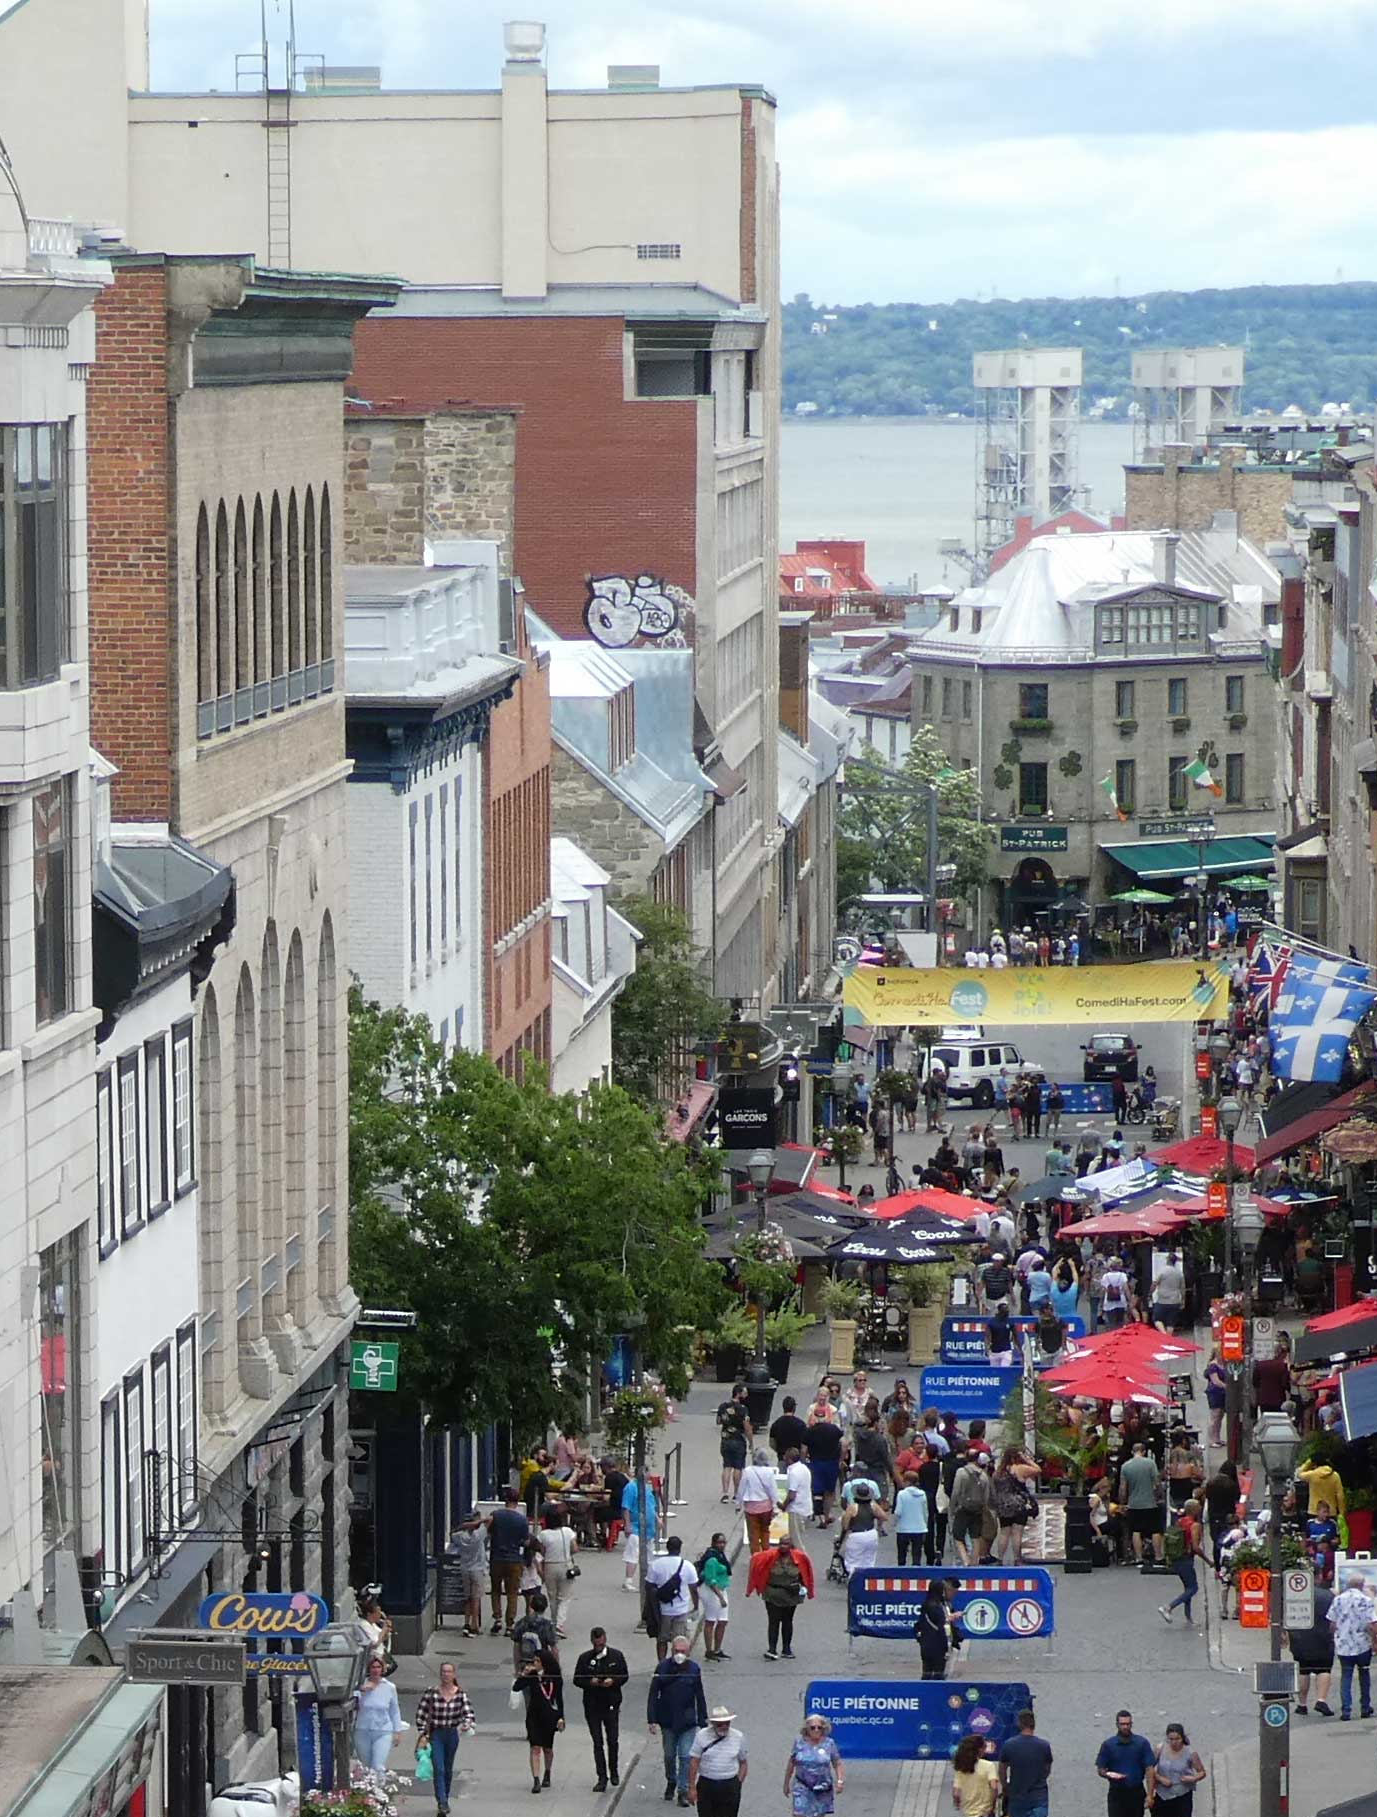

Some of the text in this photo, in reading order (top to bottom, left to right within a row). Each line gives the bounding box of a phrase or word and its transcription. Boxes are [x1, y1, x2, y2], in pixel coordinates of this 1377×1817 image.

[1022, 830, 1043, 838] PUB
[950, 990, 983, 1006] Fest
[1075, 996, 1187, 1008] ComediHaFest.com
[911, 1230, 961, 1240] Coors
[946, 1341, 965, 1350] RUE
[926, 1374, 1001, 1386] RUE PIÉTONNE
[856, 1604, 883, 1616] RUE
[135, 1653, 183, 1674] Sport
[196, 1653, 238, 1673] Chic
[811, 1694, 920, 1710] RUE PIÉTONNE
